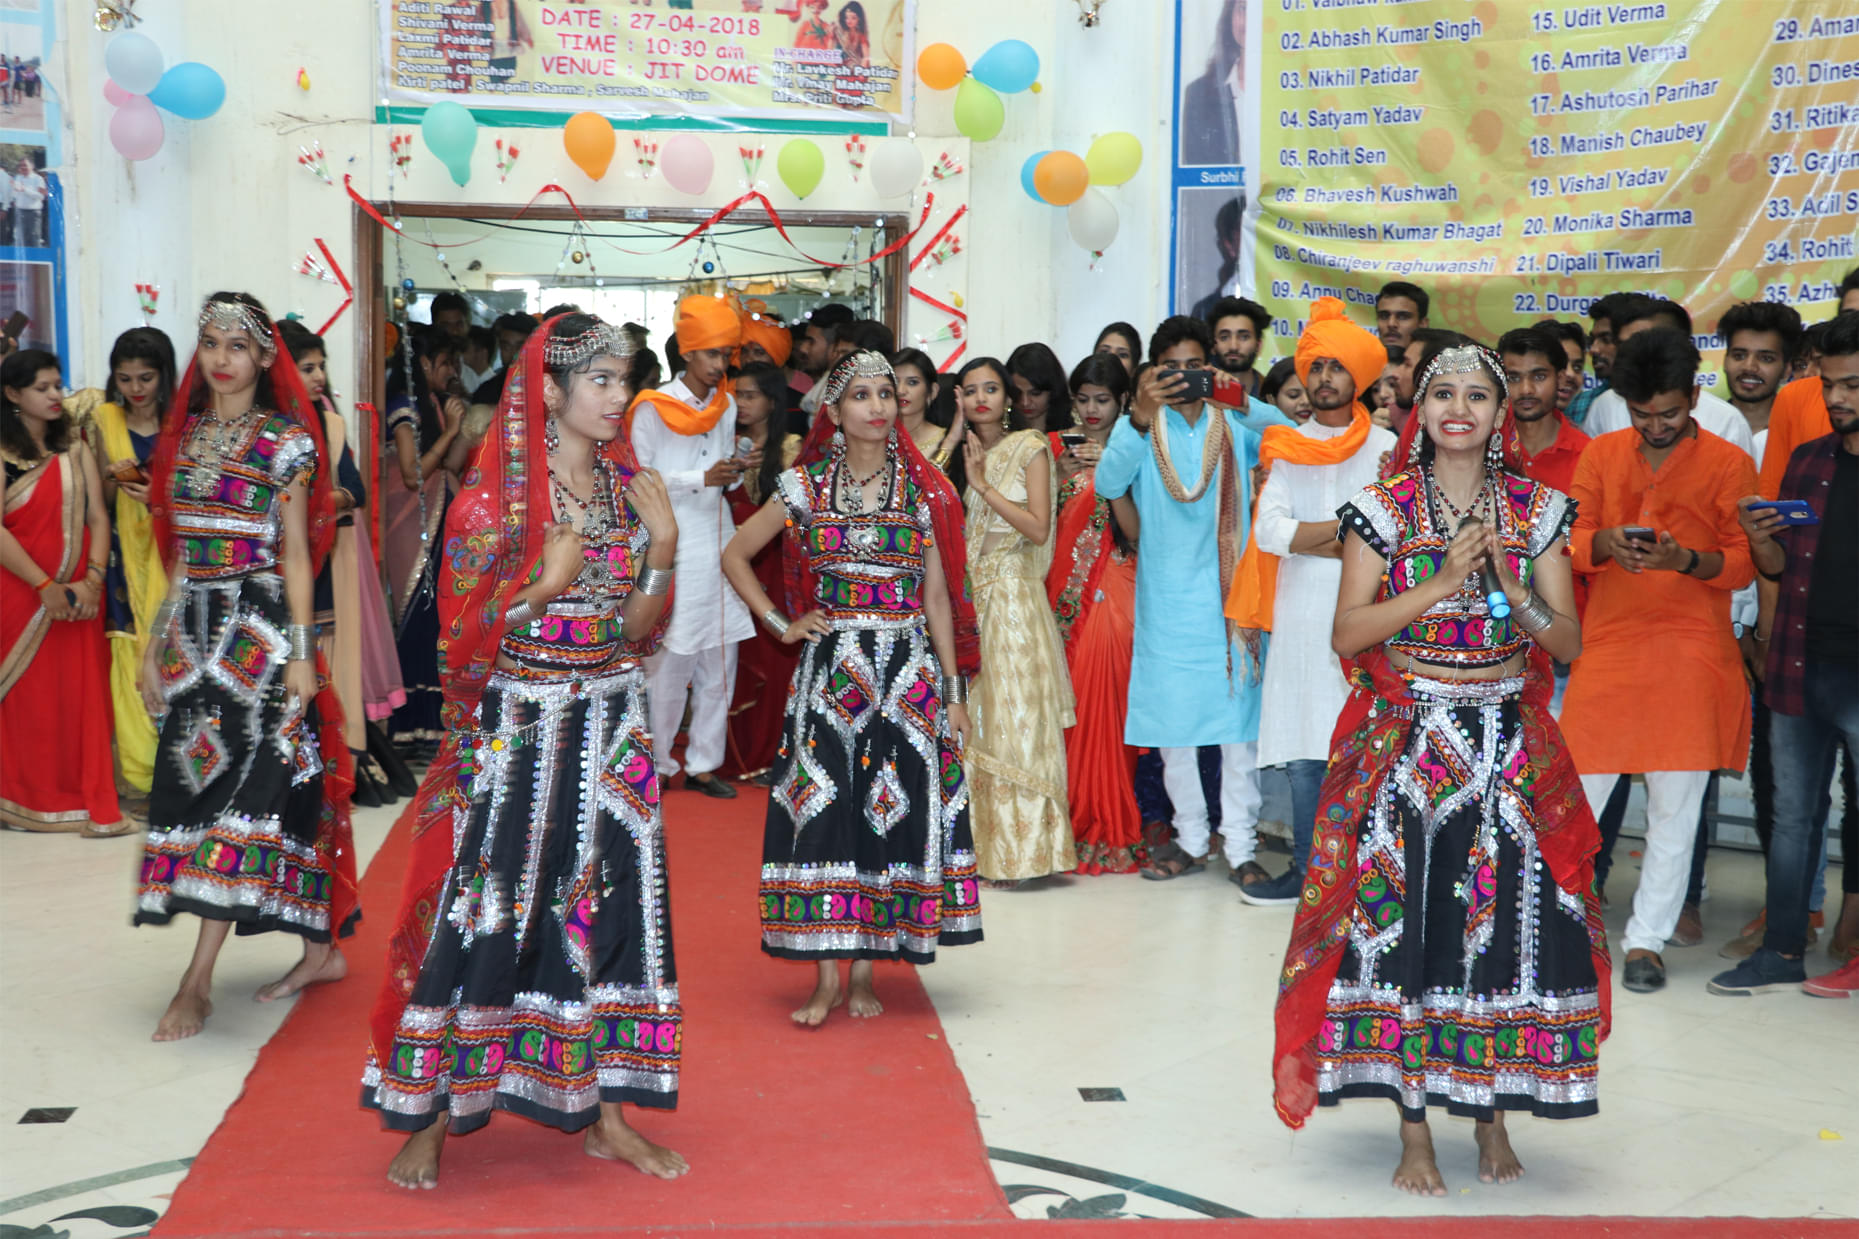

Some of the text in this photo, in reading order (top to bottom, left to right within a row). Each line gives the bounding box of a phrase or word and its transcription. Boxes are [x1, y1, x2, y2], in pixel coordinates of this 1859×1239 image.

[399, 16, 496, 32] Shivani Verma
[542, 8, 601, 28] DATE
[630, 13, 760, 36] 27-04-2018
[1532, 3, 1665, 31] 15. Udit Verma
[443, 34, 492, 46] Patidar
[1281, 17, 1481, 49] 02. Abhash Kumar Singh
[1775, 20, 1804, 41] 29.
[398, 46, 491, 61] Amrita Verma
[557, 33, 617, 53] TIME
[647, 38, 707, 57] 10:30
[398, 61, 516, 77] Poonam Chouhan
[1530, 44, 1688, 71] 16. Amrita Verma
[542, 56, 617, 76] VENUE
[644, 62, 686, 79] JIT
[695, 65, 760, 85] DOME
[1280, 65, 1419, 89] 03. Nikhil Patidar
[1772, 66, 1802, 86] 30.
[1530, 79, 1719, 114] 17. Ashutosh Parihar
[1280, 106, 1423, 130] 04. Satyam Yadav
[1771, 109, 1800, 131] 31.
[1529, 121, 1707, 156] 18. Manish Chaubey
[1280, 147, 1386, 167] 05. Rohit Sen
[1769, 155, 1798, 175] 32.
[1276, 183, 1457, 203] 06. Bhavesh Kushwah
[1529, 167, 1668, 197] 19. Vishal Yadav
[1768, 198, 1796, 219] 33.
[1303, 221, 1377, 240] Nikhilesh
[1383, 223, 1439, 240] Kumar
[1443, 222, 1502, 242] Bhagat
[1523, 208, 1693, 235] 20. Monika Sharma
[1274, 244, 1496, 275] 08. Chiranjeev raghuwanshi
[1765, 236, 1853, 262] 34. Rohit
[1516, 250, 1661, 275] 21. Dipali Tiwari
[1272, 281, 1295, 298] 09.
[1514, 295, 1540, 312] 22.
[1271, 319, 1293, 336] 10.
